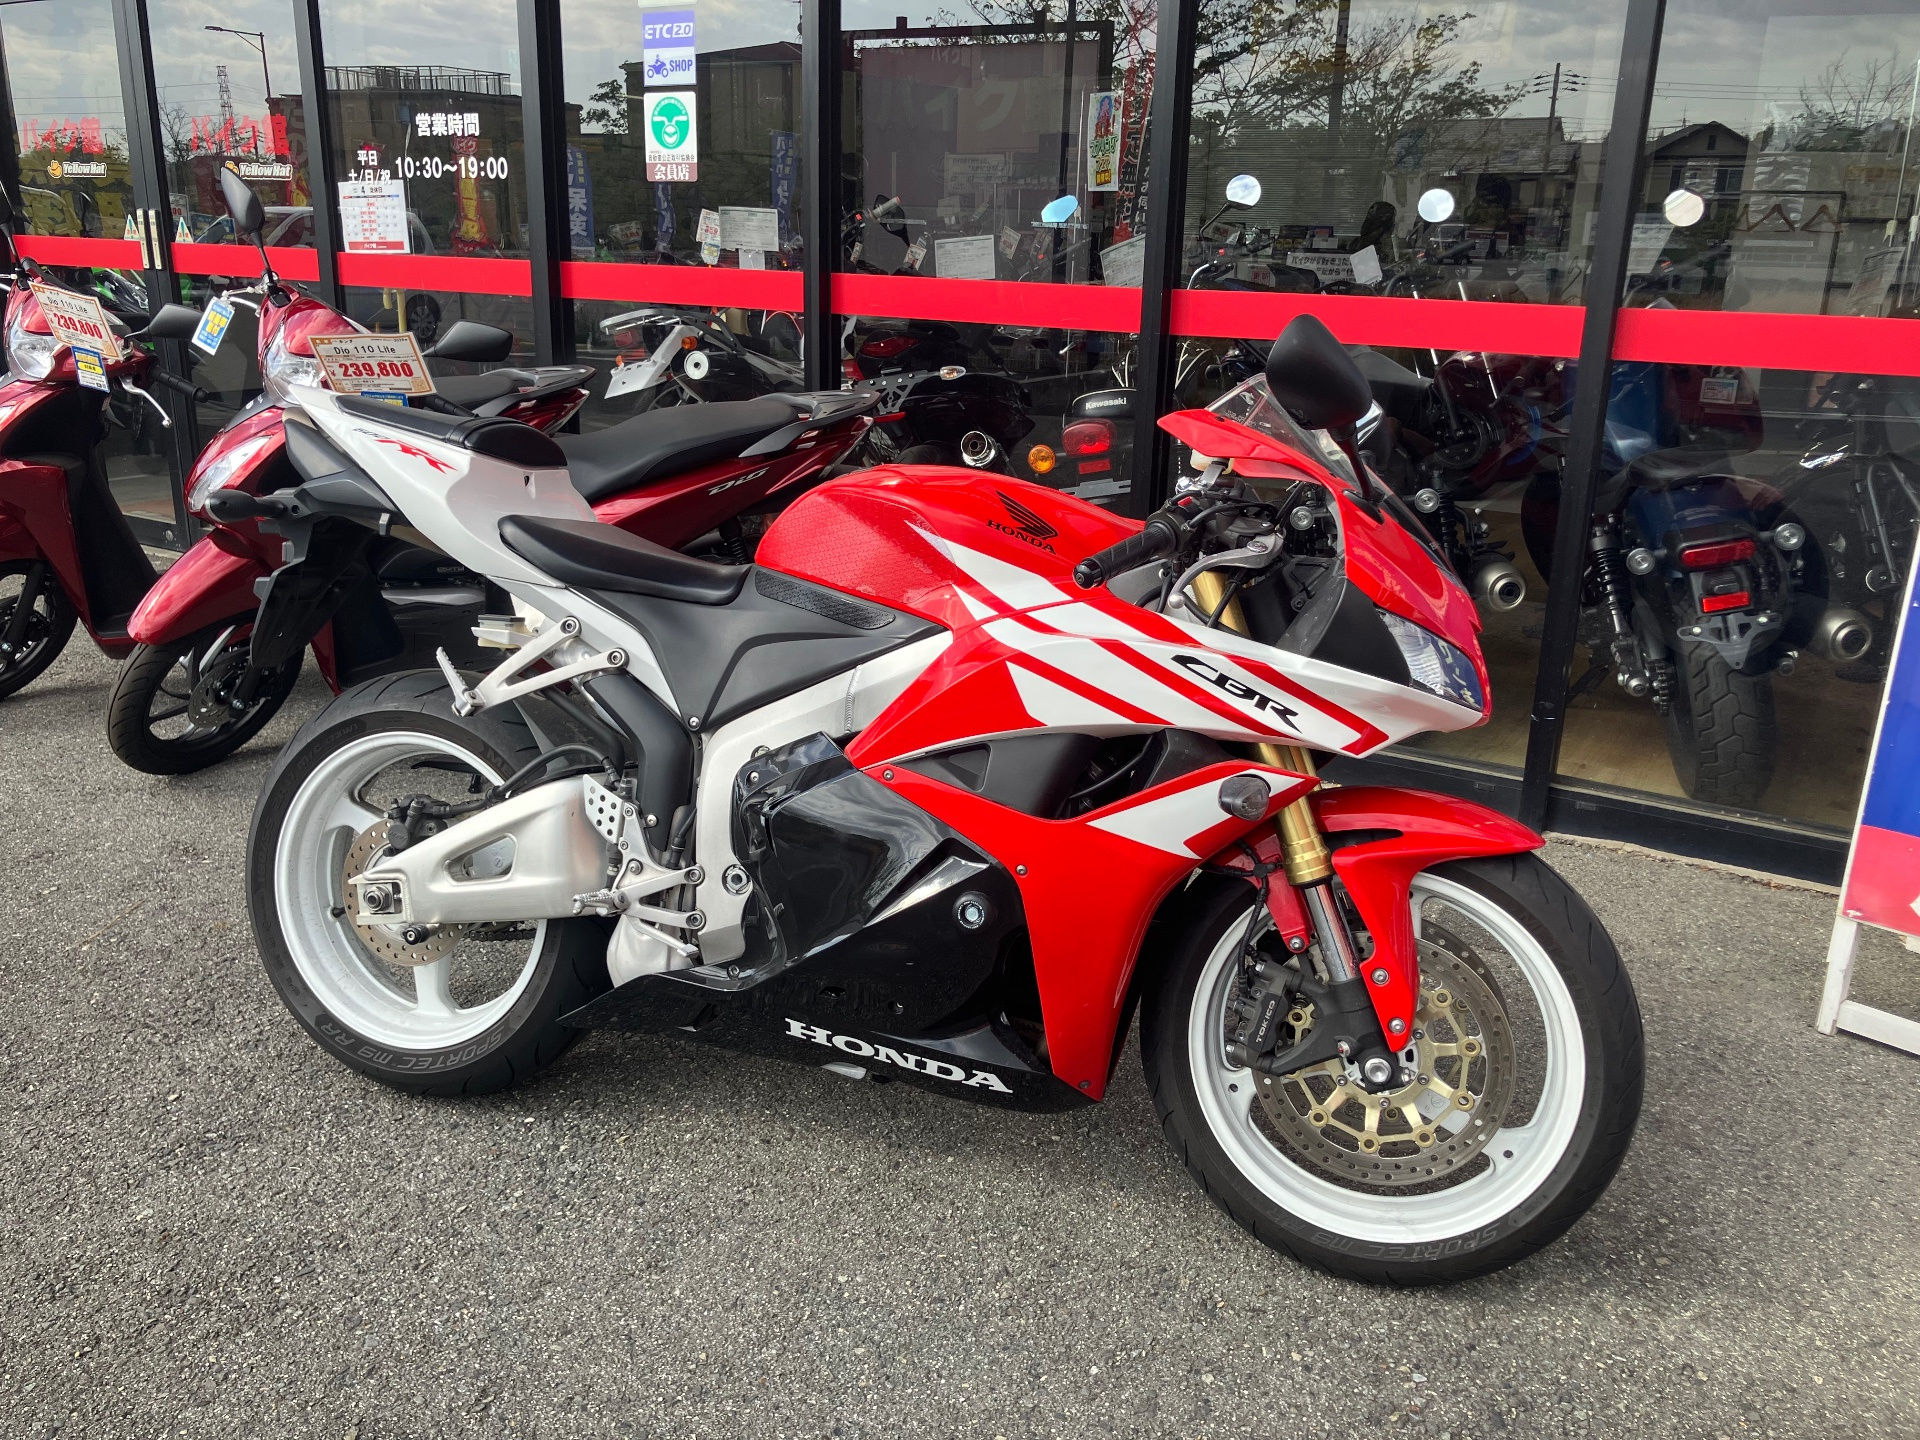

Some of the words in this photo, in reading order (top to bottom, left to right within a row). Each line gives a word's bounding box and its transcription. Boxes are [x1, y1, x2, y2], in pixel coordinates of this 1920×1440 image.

[669, 59, 693, 72] SHOP
[22, 116, 104, 154] バイク館
[191, 113, 290, 155] バイク館
[415, 113, 480, 137] 営業時間
[357, 150, 378, 166] 平日
[348, 169, 392, 185] 土/日/祝
[654, 163, 690, 180] 会員店
[61, 299, 73, 310] 110
[53, 311, 103, 341] 239,800
[333, 346, 350, 355] Dio
[353, 346, 375, 354] 110
[377, 345, 396, 354] Lite
[338, 362, 414, 378] 239,800
[1085, 397, 1127, 410] Kawasaki
[986, 519, 1057, 555] HONDA
[1171, 653, 1303, 735] CBR
[1255, 1000, 1276, 1043] TOKICO
[320, 1021, 356, 1047] RR
[357, 1045, 394, 1065] M9
[397, 1024, 505, 1071] SPORTEC
[785, 1017, 1013, 1094] HONDA
